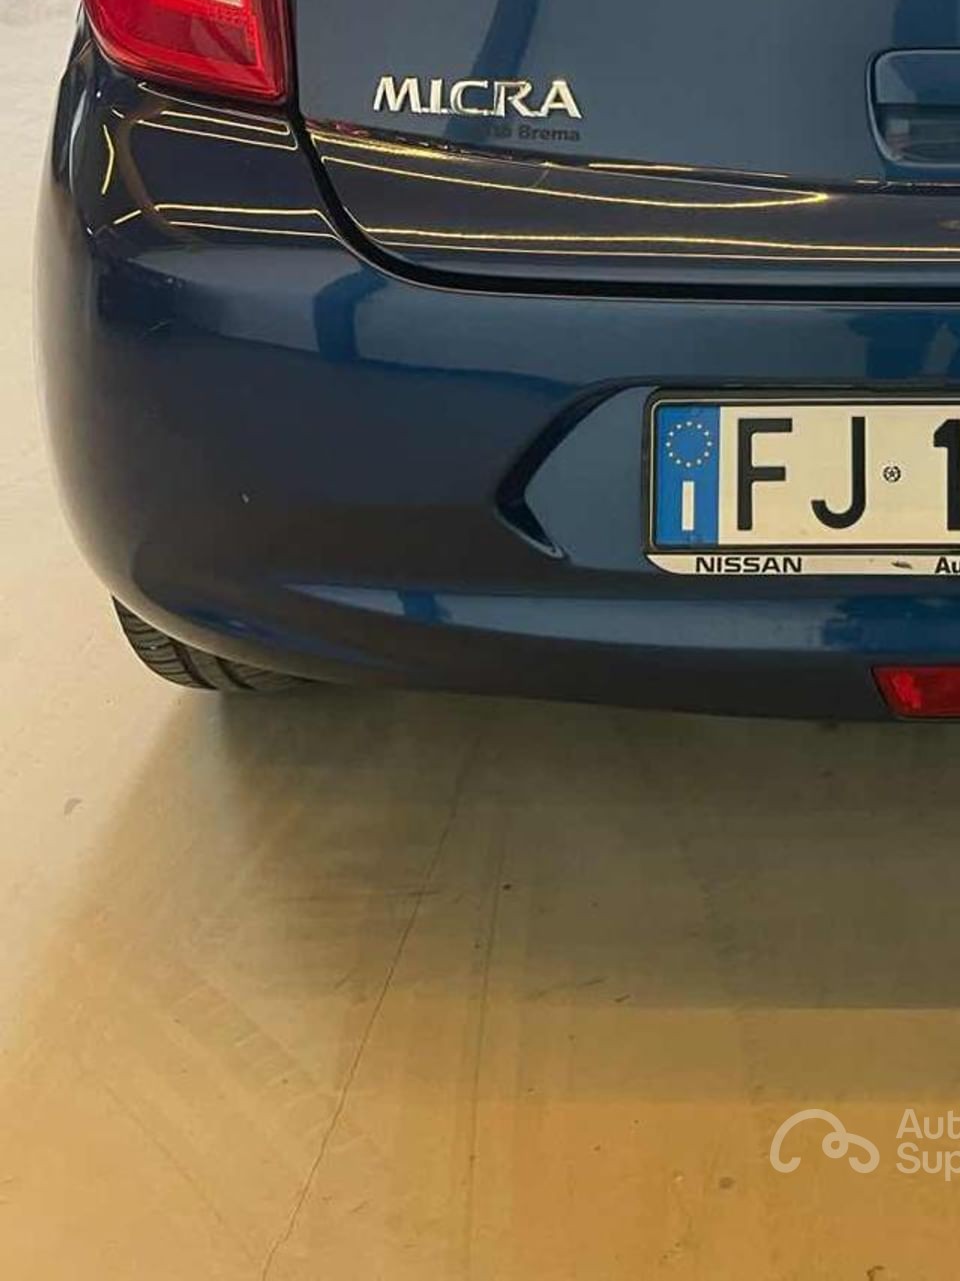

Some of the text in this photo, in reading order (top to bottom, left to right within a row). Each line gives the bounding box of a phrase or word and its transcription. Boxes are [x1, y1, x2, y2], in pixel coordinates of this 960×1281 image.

[373, 76, 583, 119] MICRA
[736, 416, 867, 530] FJ
[695, 557, 802, 573] NISSAN
